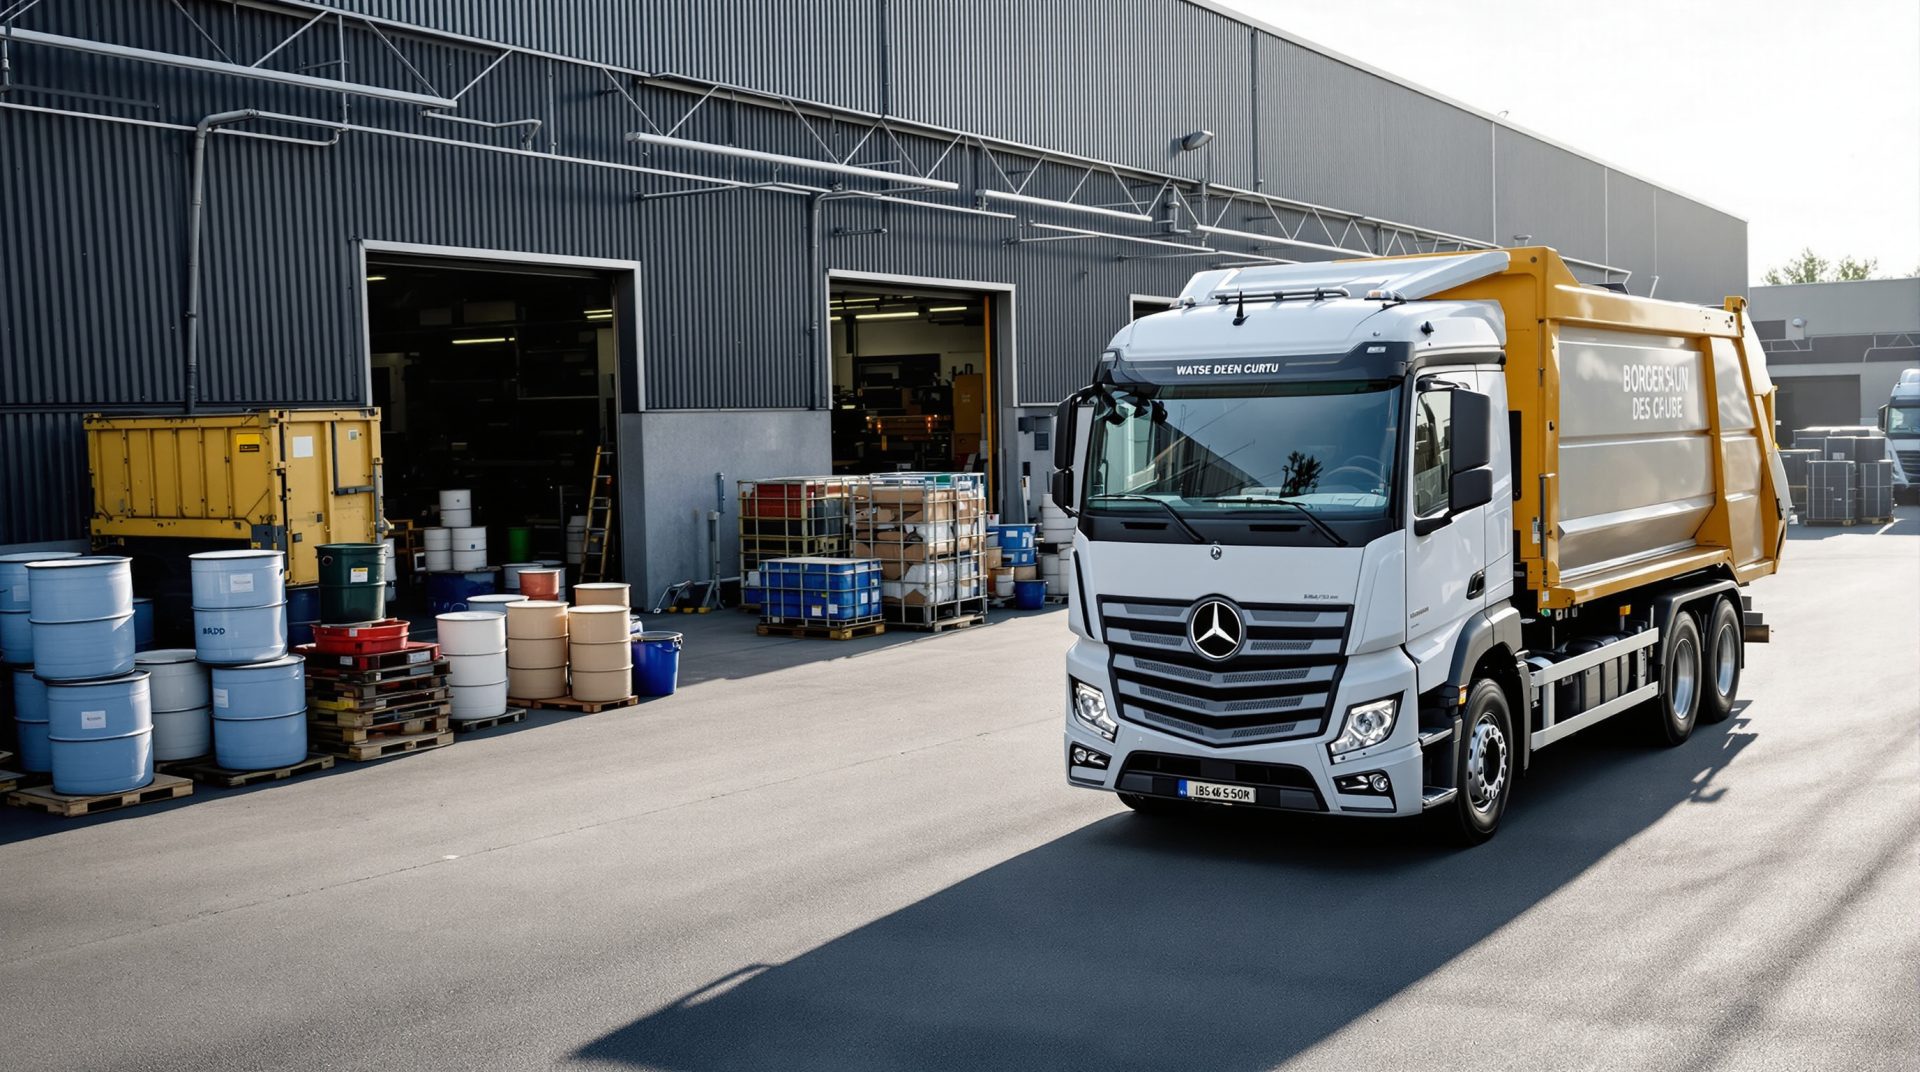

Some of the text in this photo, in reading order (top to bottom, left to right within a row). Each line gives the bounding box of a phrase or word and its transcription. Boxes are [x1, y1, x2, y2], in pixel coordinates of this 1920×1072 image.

[1176, 365, 1212, 375] WATSE
[1213, 364, 1242, 374] DEEN
[1632, 397, 1651, 420] DES
